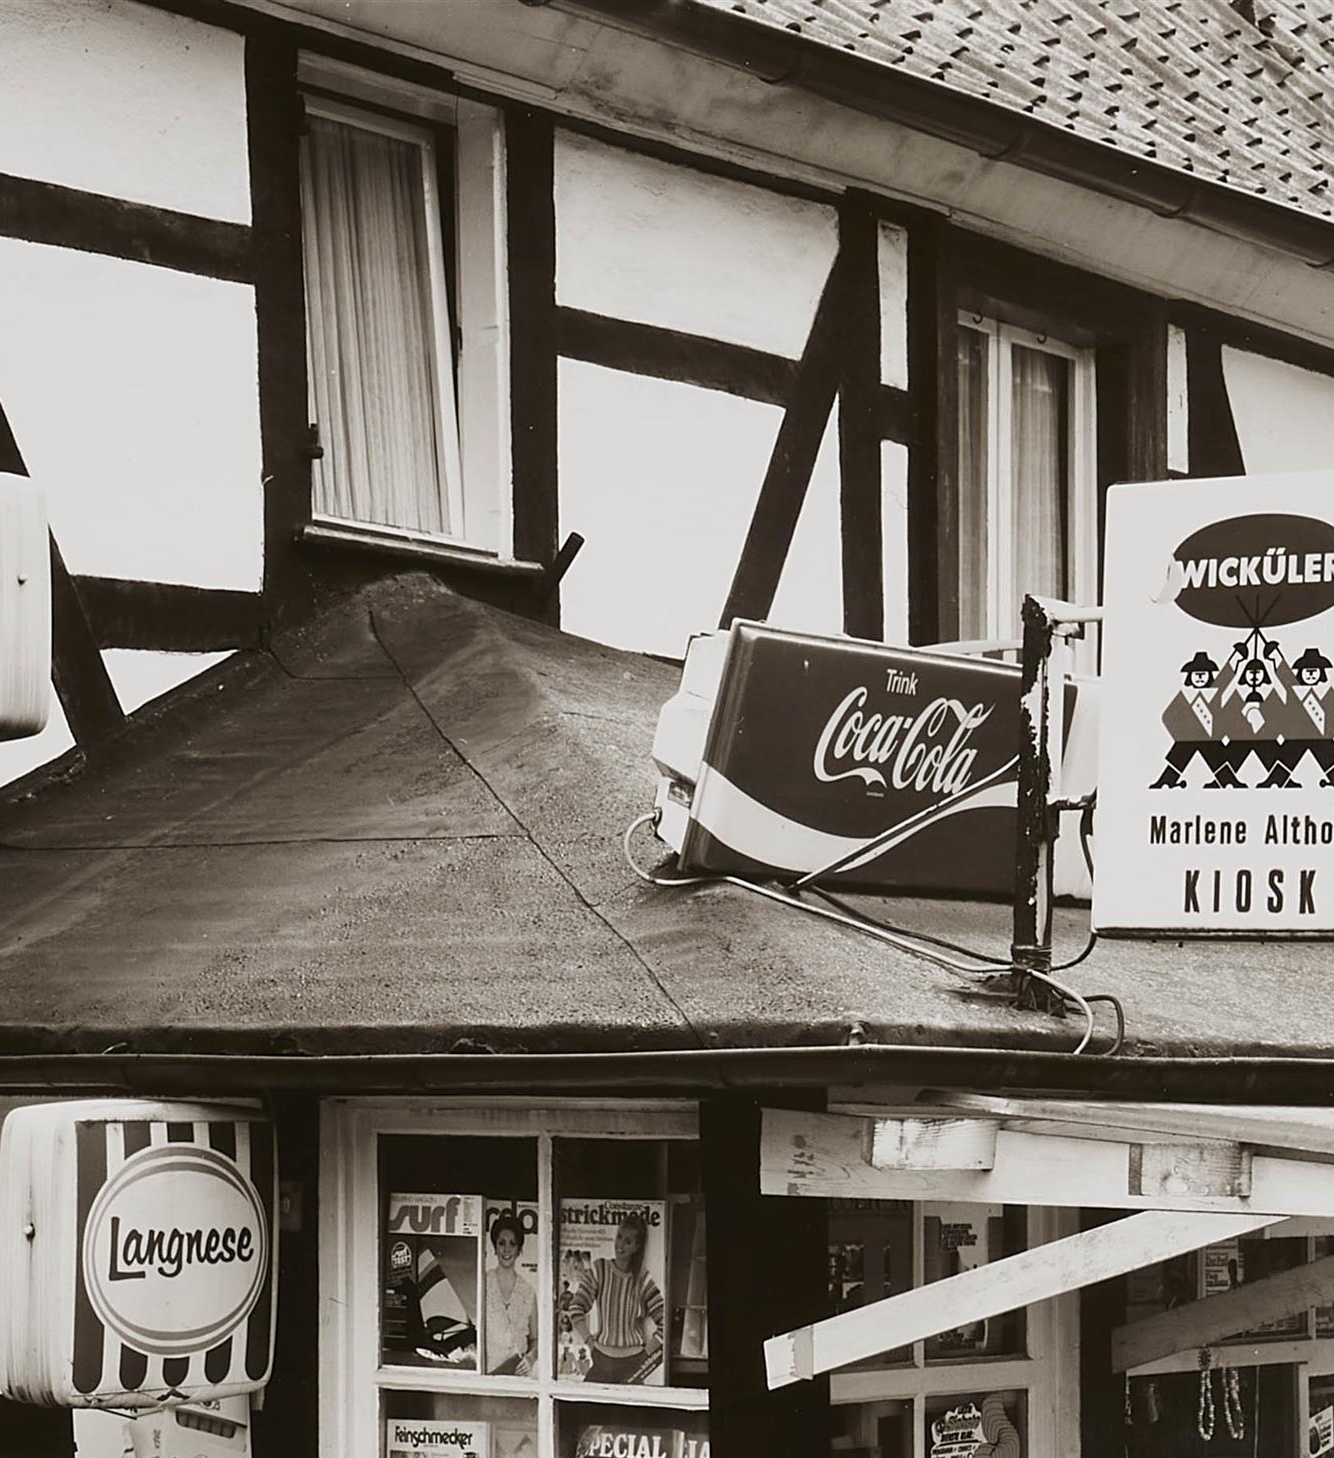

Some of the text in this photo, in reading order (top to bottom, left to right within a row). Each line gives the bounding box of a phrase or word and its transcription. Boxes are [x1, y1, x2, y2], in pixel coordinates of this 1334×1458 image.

[886, 669, 919, 696] Trink
[813, 686, 995, 796] Coca-Cola
[1150, 815, 1246, 845] Marlene
[1184, 869, 1316, 914] KIOSK
[389, 1196, 461, 1233] surf
[108, 1216, 254, 1281] Langnese
[396, 1426, 472, 1449] Feinschmecker
